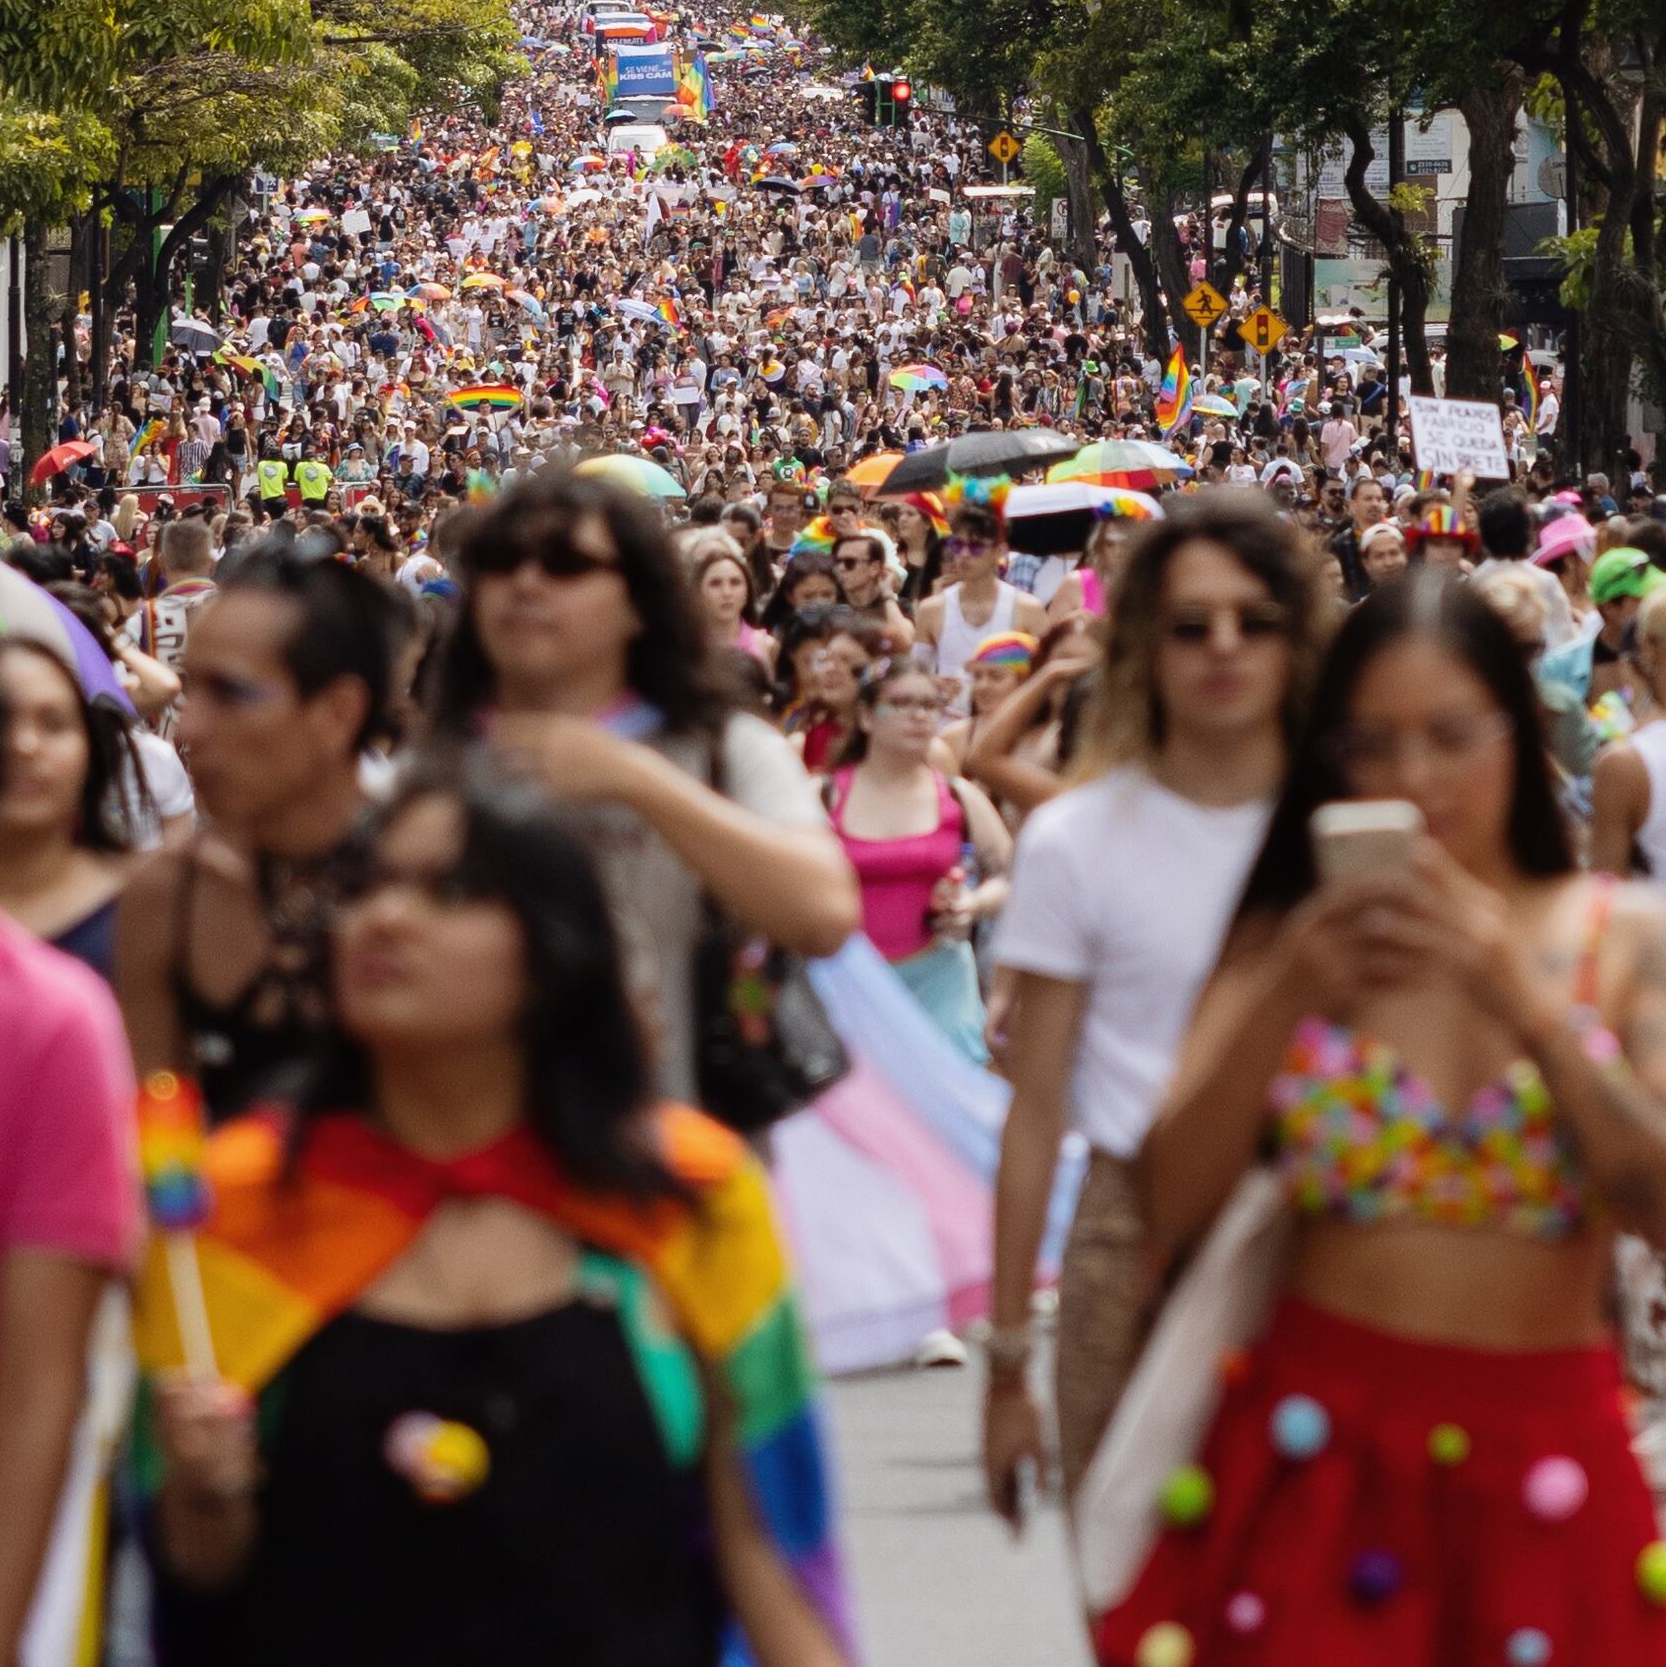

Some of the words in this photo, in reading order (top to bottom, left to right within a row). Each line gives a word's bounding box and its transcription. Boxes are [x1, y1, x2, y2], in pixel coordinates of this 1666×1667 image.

[646, 71, 672, 79] CAM
[1427, 430, 1445, 446] SE
[1422, 446, 1454, 468] SIN
